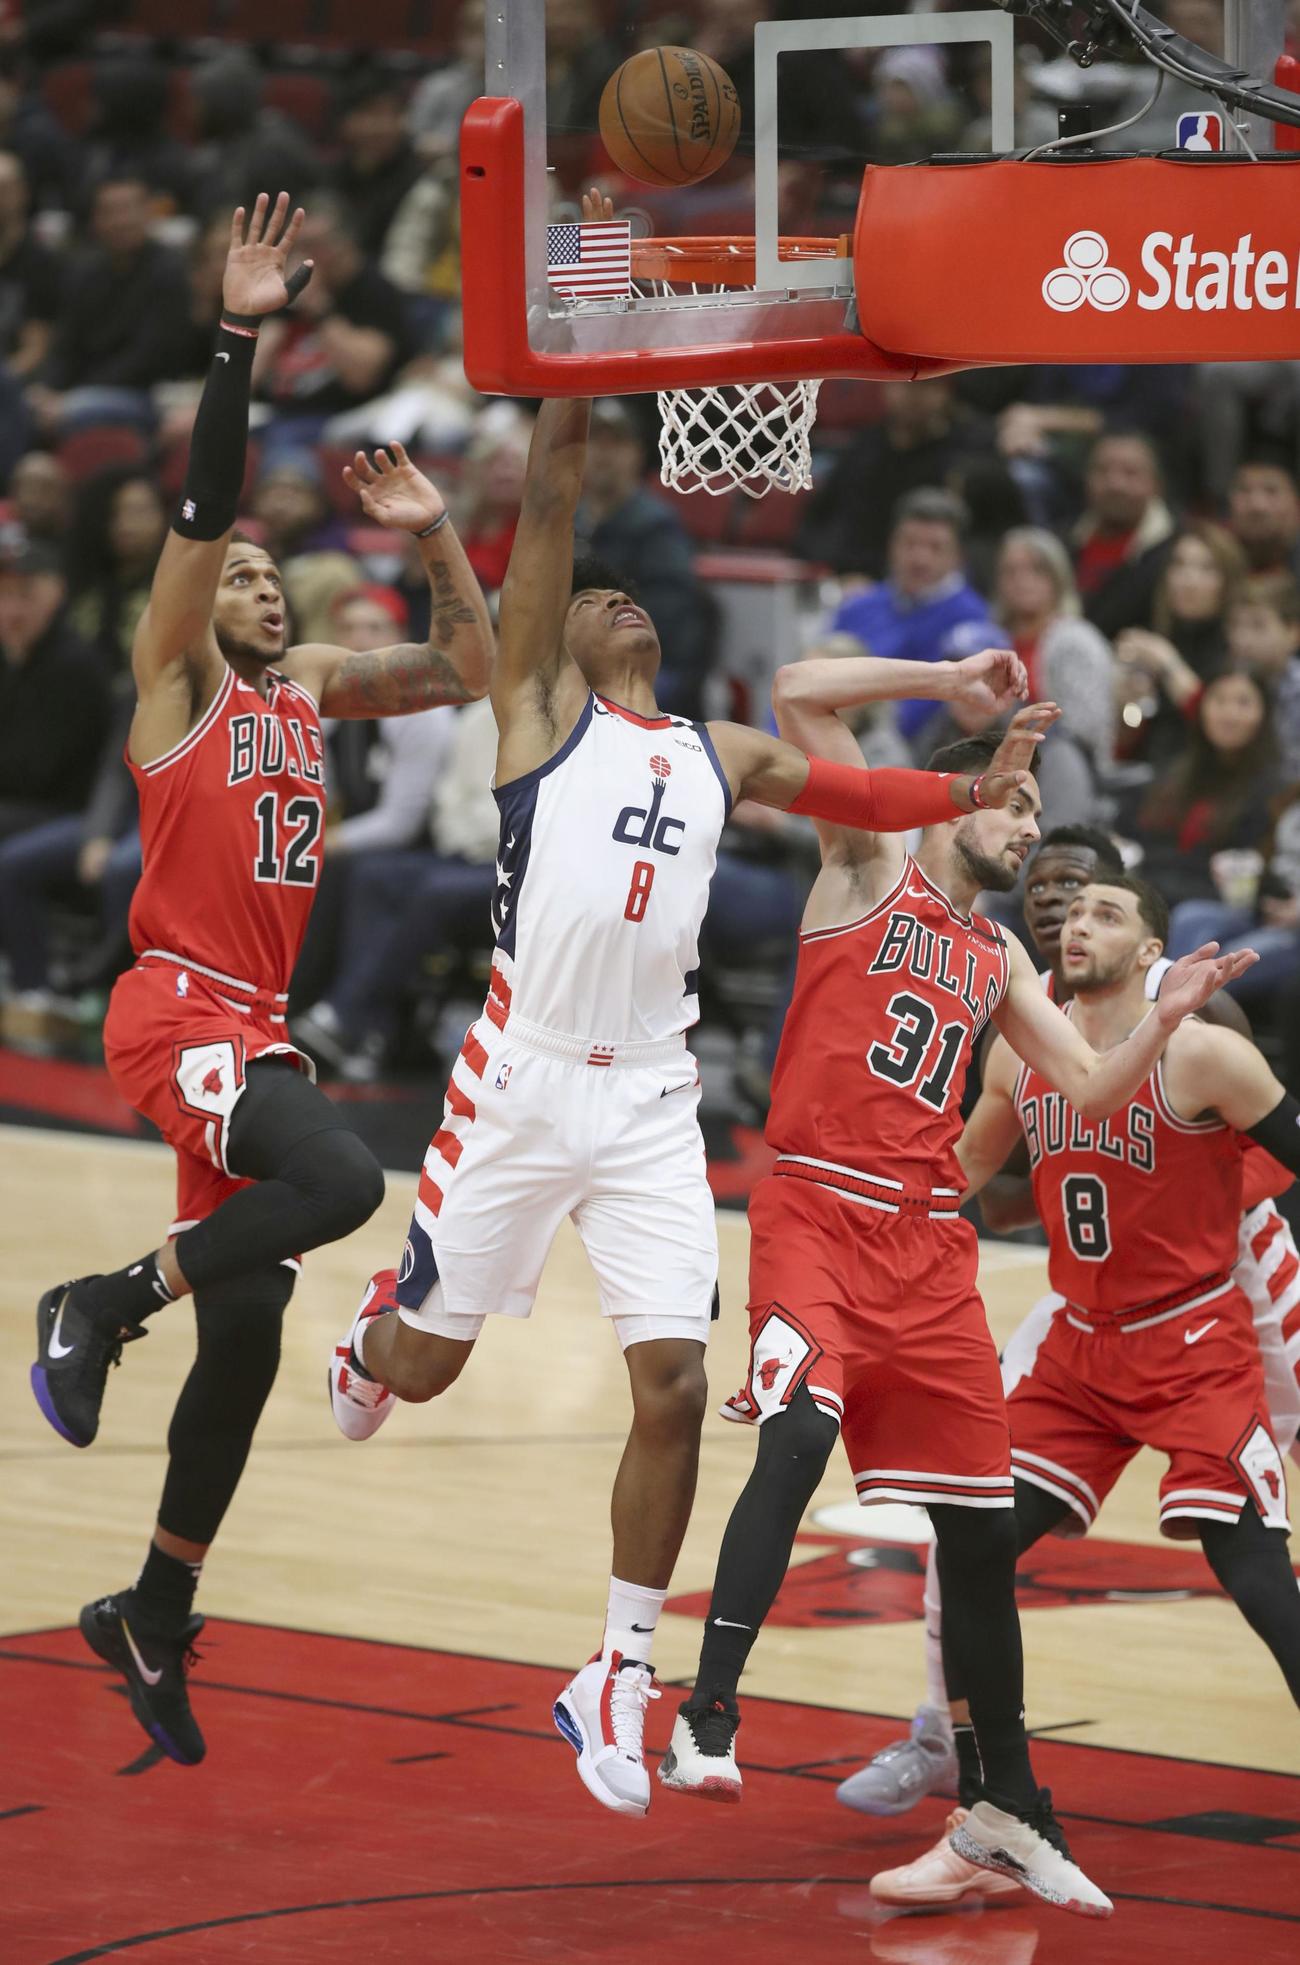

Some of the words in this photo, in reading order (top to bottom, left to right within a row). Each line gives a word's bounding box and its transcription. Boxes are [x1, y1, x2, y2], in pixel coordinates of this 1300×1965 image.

[1137, 231, 1289, 311] State
[254, 792, 323, 888] 12
[624, 861, 655, 923] 8
[866, 991, 968, 1113] 31
[1021, 1092, 1155, 1174] BULLS
[1061, 1173, 1112, 1262] 8
